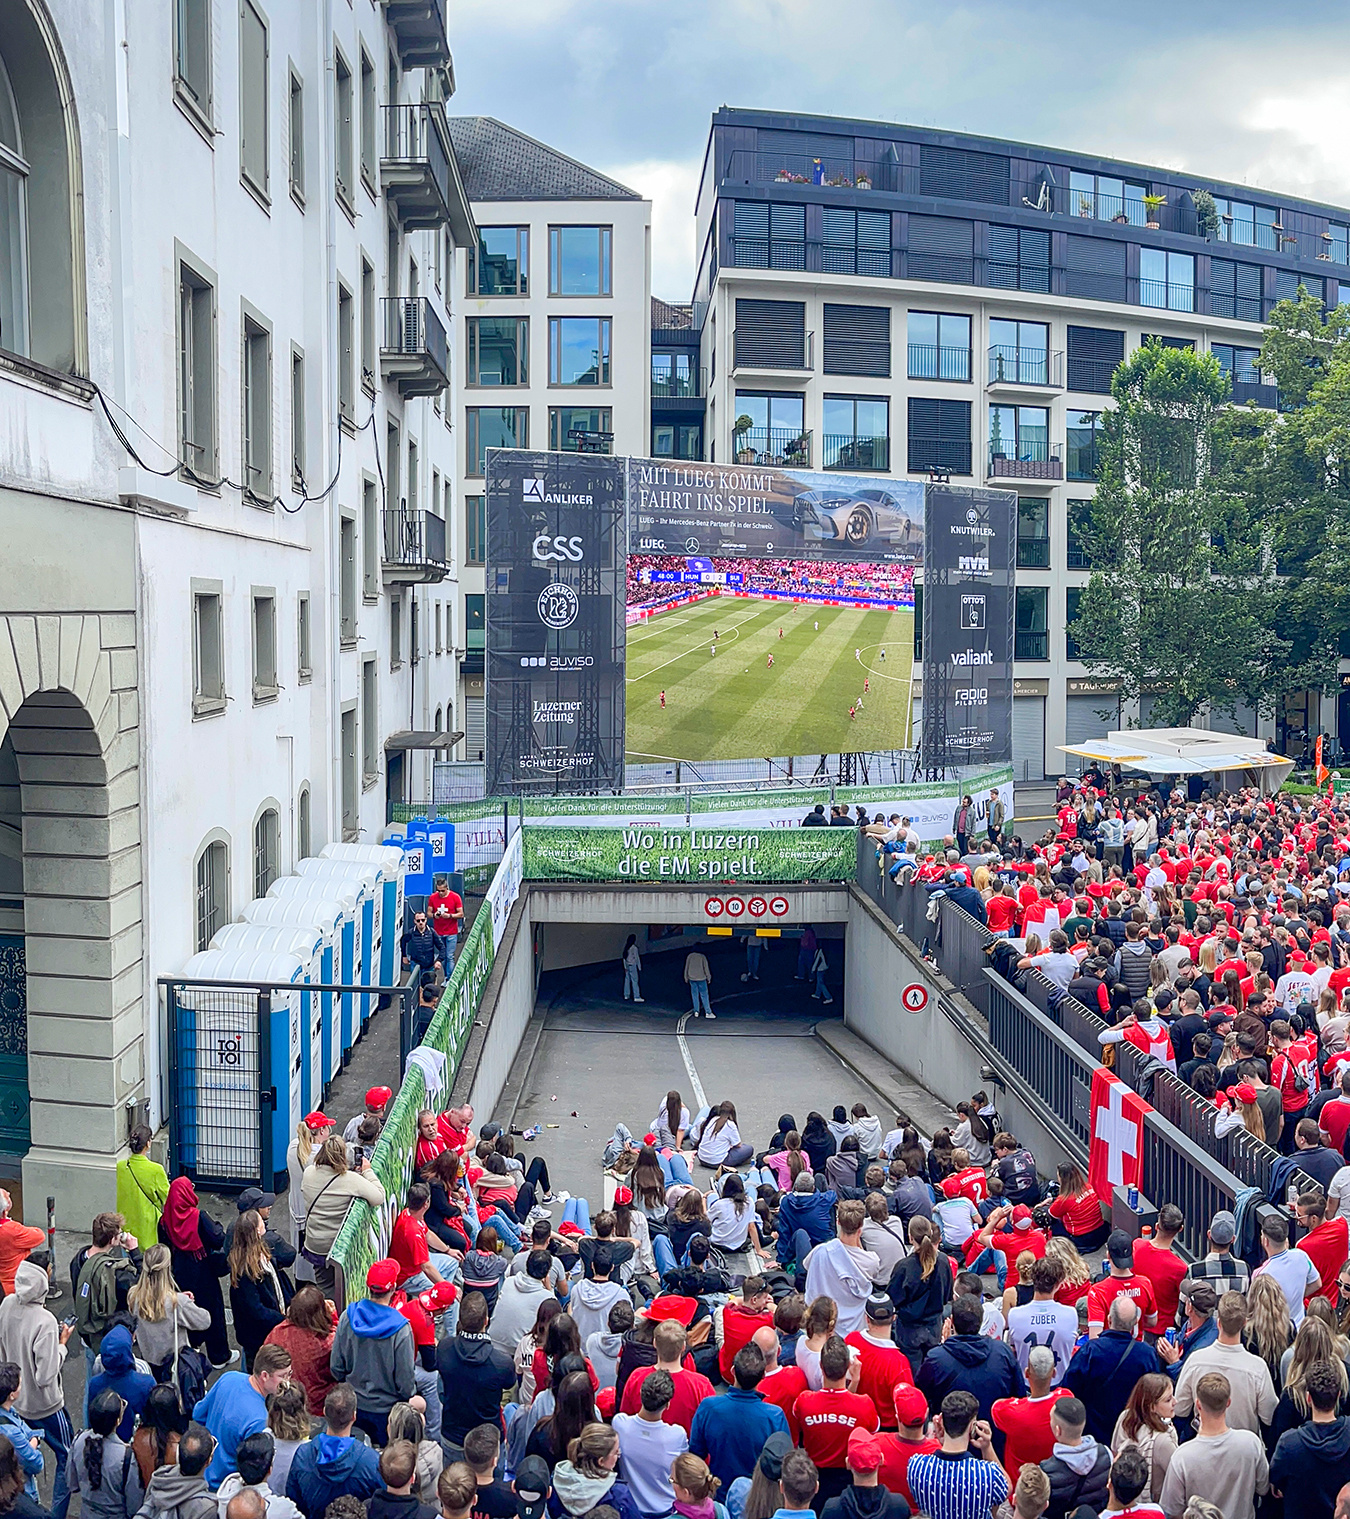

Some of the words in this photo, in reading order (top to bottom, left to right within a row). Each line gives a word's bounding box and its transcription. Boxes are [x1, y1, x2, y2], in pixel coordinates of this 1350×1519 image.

[640, 467, 669, 485] MIT
[675, 468, 715, 488] LUEG
[719, 472, 774, 492] KOMMT
[544, 494, 593, 505] ANLIKER
[640, 490, 692, 510] FAHRT
[697, 493, 723, 511] INS
[728, 495, 774, 514] SPIEL.
[669, 518, 709, 527] Mercedes-Benz
[710, 519, 729, 528] Partner
[737, 520, 742, 528] in
[743, 521, 751, 529] der
[752, 522, 774, 530] Schweiz.
[533, 535, 584, 561] CSS
[640, 538, 667, 549] LUEG.
[541, 586, 575, 604] EICHHOF
[963, 597, 984, 605] OTTO'S
[951, 649, 993, 666] valiant
[533, 700, 582, 712] Luzerner
[533, 711, 574, 724] Zeitung
[945, 735, 994, 745] SCHWEIZERHOF
[520, 757, 594, 768] SCHWEIZERHOF
[543, 804, 566, 812] Vielen
[589, 803, 598, 811] für
[601, 803, 612, 811] die
[614, 803, 667, 812] Unterstützung!
[708, 800, 729, 809] Vielen
[730, 799, 746, 807] Dank
[747, 799, 756, 807] für
[758, 798, 768, 806] die
[770, 795, 814, 806] Unterstützung!
[1066, 814, 1077, 824] 18
[466, 828, 505, 848] VILLA
[622, 830, 654, 849] Wo
[663, 830, 682, 849] in
[691, 831, 760, 850] Luzern
[408, 856, 421, 864] TOI
[618, 856, 650, 875] die
[660, 857, 690, 875] EM
[698, 856, 763, 878] spielt.
[732, 903, 739, 911] 10
[218, 1040, 240, 1052] TOI
[218, 1053, 240, 1064] TOI
[1030, 1314, 1057, 1325] ZUBER
[804, 1413, 857, 1427] SUISSE
